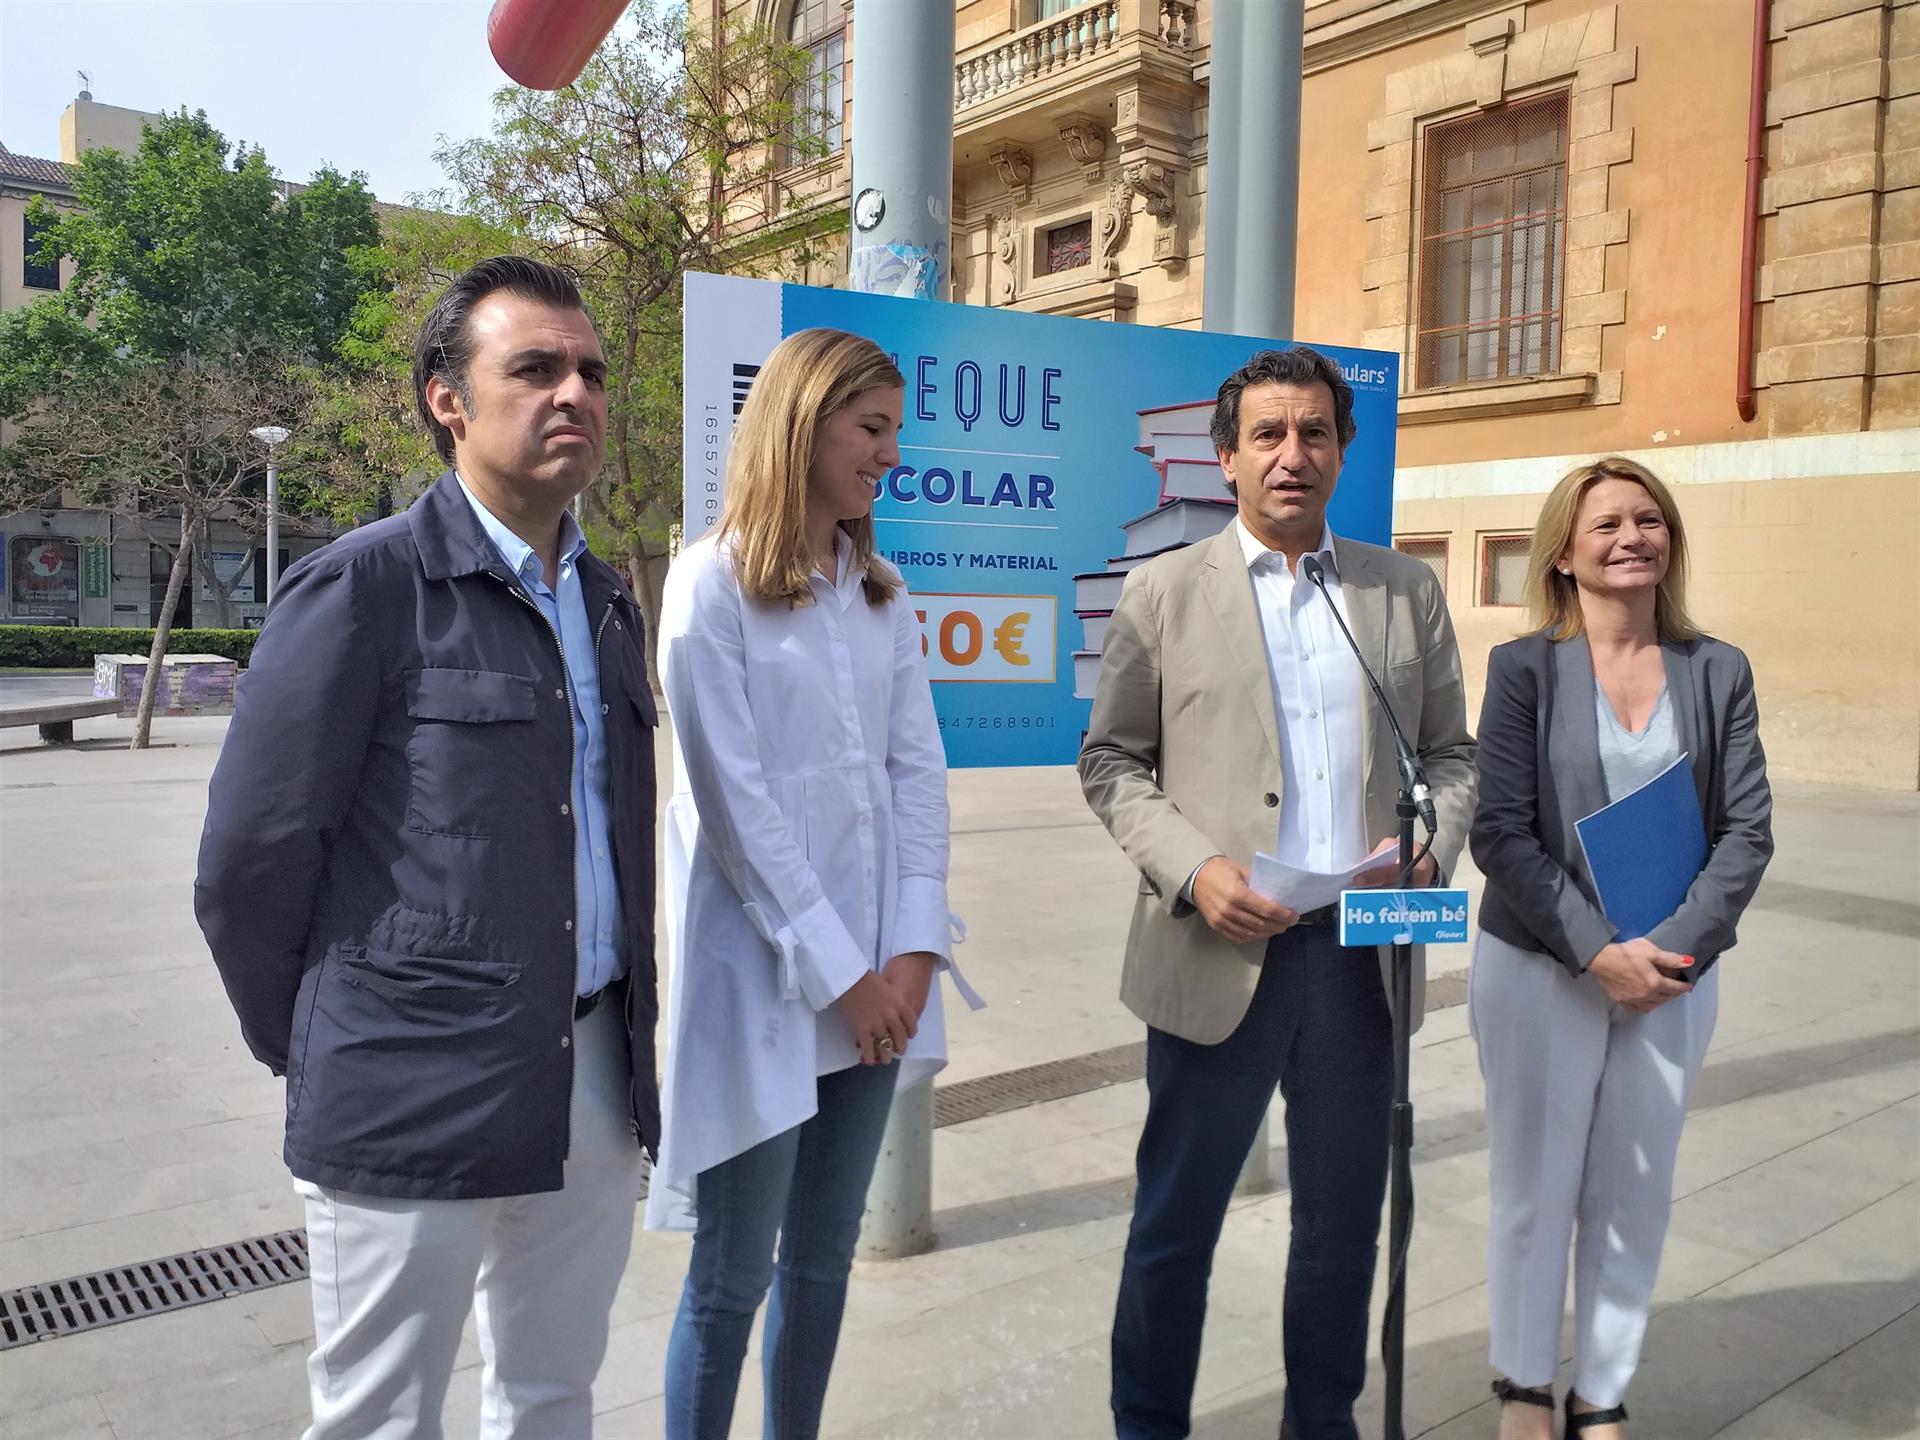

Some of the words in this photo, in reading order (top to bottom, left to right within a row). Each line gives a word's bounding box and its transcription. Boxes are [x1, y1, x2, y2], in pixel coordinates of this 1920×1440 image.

[705, 405, 717, 526] 16557868
[952, 553, 965, 568] Y
[969, 554, 1059, 571] MATERIAL
[1347, 907, 1375, 925] Ho
[1379, 906, 1437, 924] farem
[1441, 905, 1466, 922] bé
